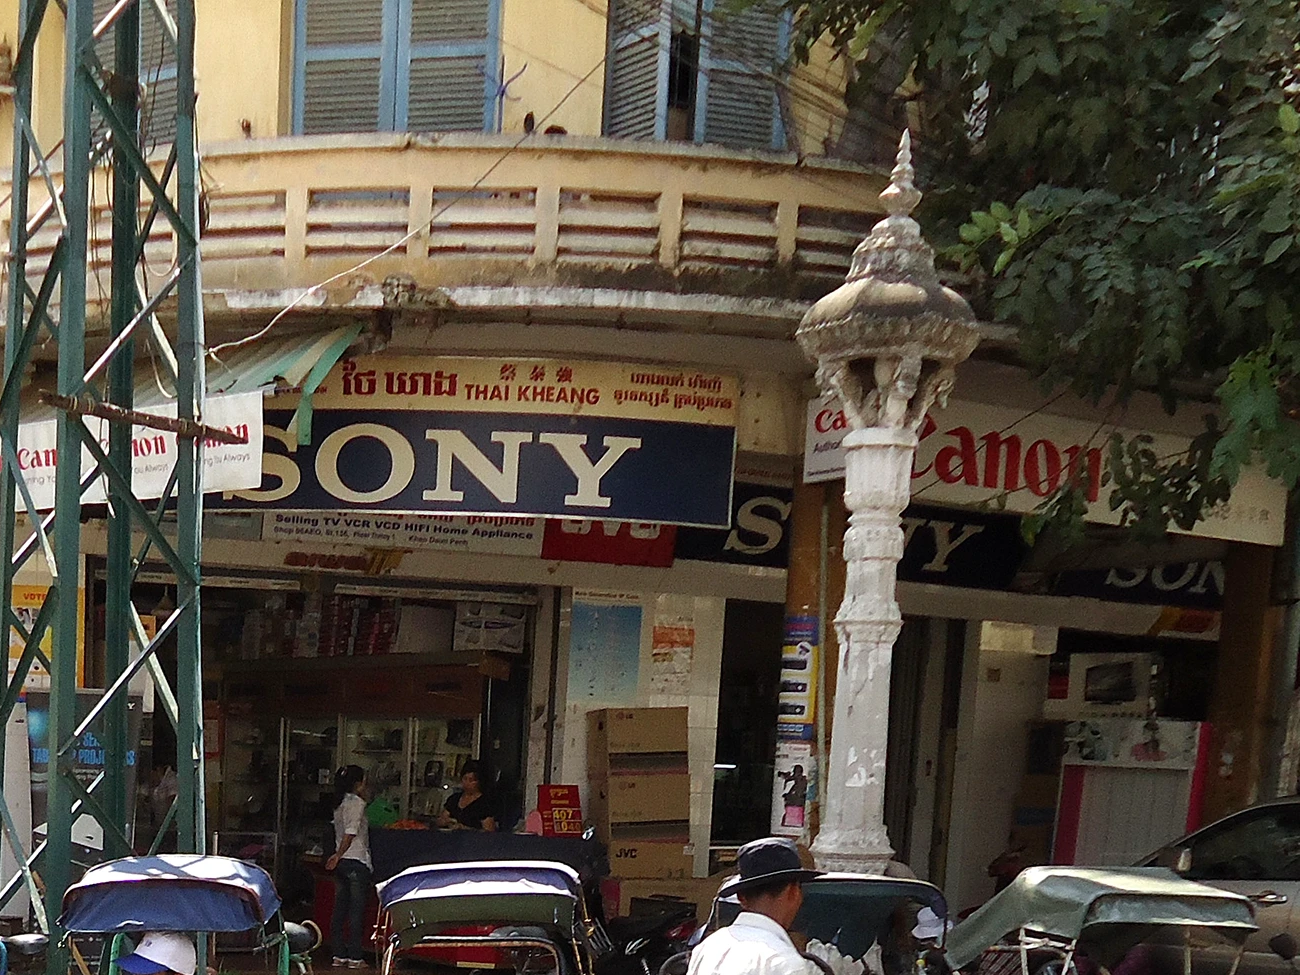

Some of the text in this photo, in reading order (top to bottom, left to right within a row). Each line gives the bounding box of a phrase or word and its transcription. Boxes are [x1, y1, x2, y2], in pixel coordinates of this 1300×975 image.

[465, 384, 600, 405] THAI KHEANG
[17, 447, 57, 471] Can
[223, 422, 642, 508] SONY
[275, 514, 534, 540] Selling TV VCR VCD HIFI Home Appliance
[615, 848, 638, 858] JVC
